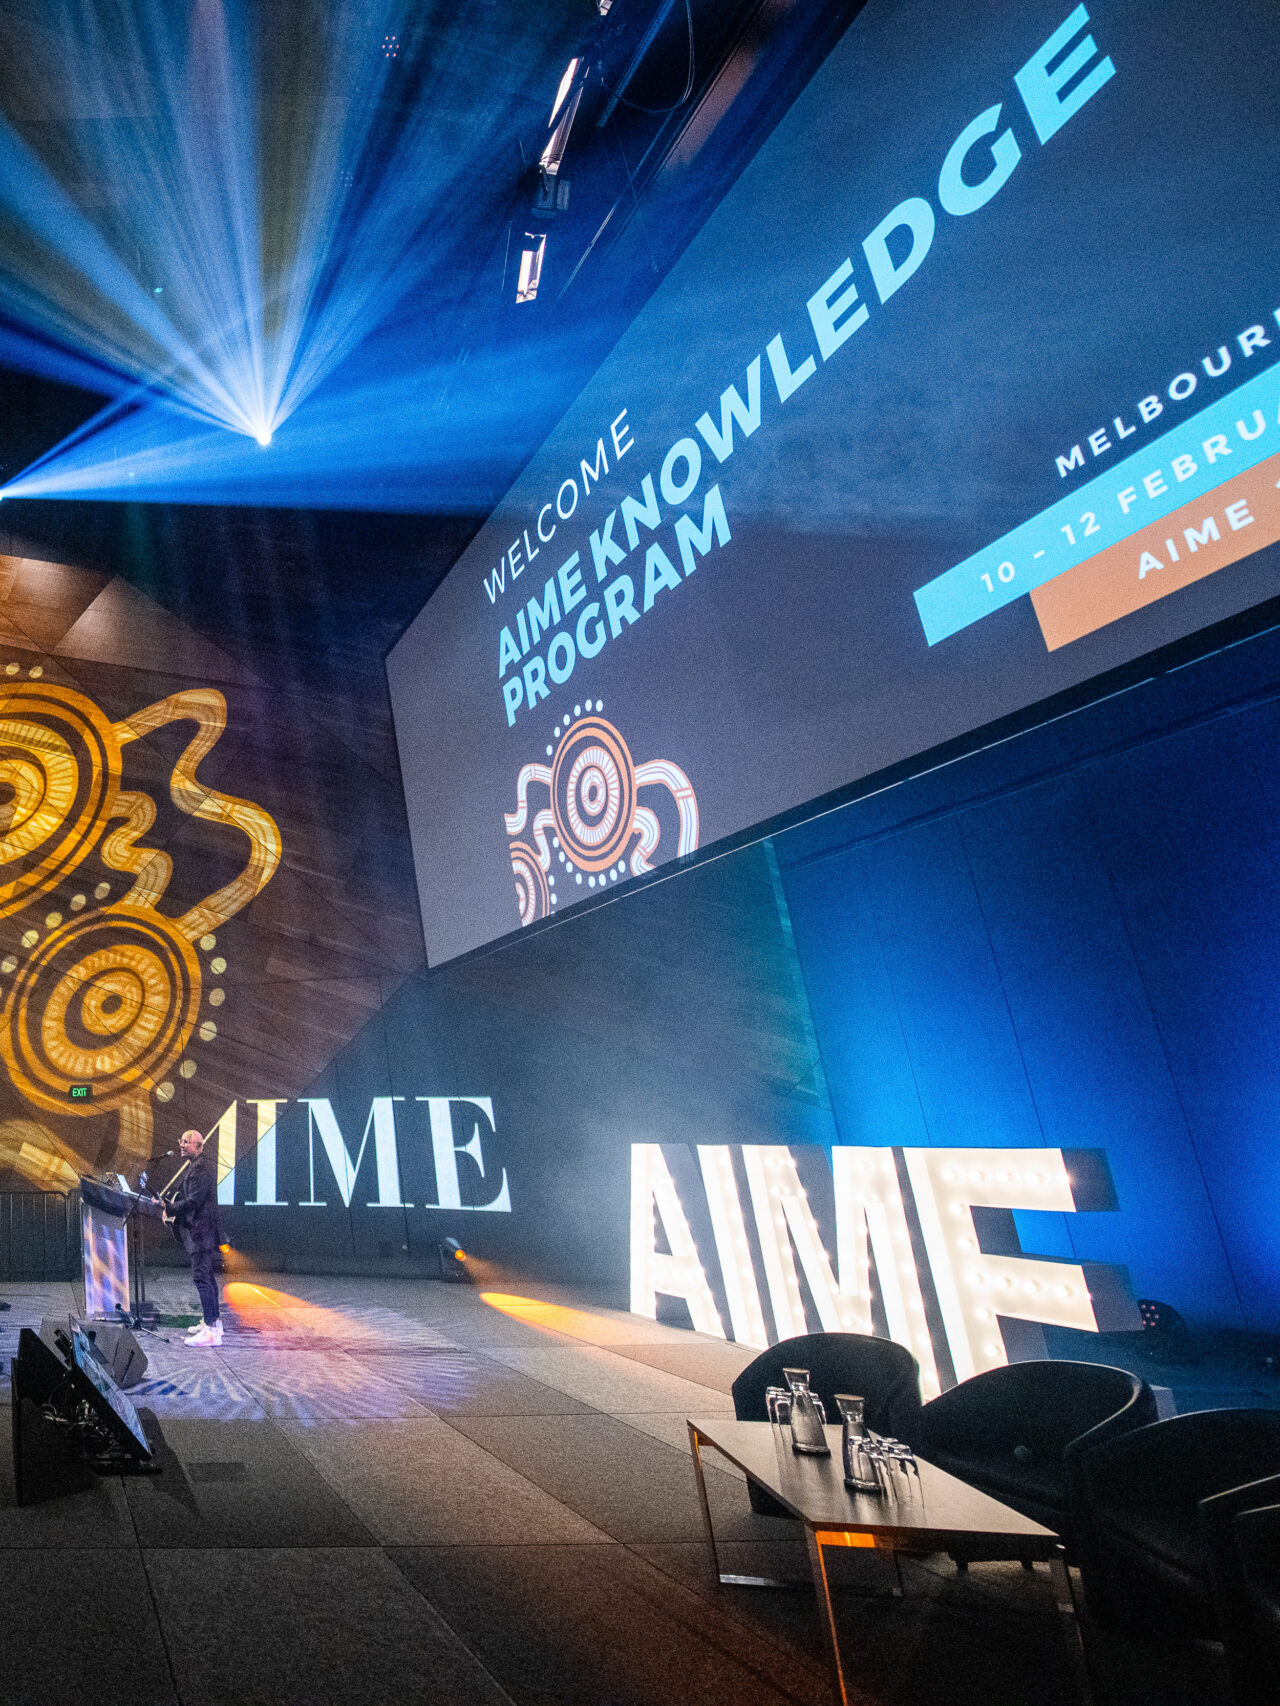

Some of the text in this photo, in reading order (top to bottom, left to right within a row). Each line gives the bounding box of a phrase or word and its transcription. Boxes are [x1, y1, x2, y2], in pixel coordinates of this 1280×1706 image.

[498, 2, 1117, 678] AIME KNOWLEDGE
[1054, 308, 1280, 478] MELBOUR
[483, 408, 635, 604] WELCOME
[980, 561, 1016, 593] 10
[1060, 511, 1100, 546] 12
[1116, 402, 1280, 515] FEBRU
[1138, 499, 1254, 580] AIME
[502, 483, 732, 728] PROGRAM
[72, 1087, 87, 1097] EXIT
